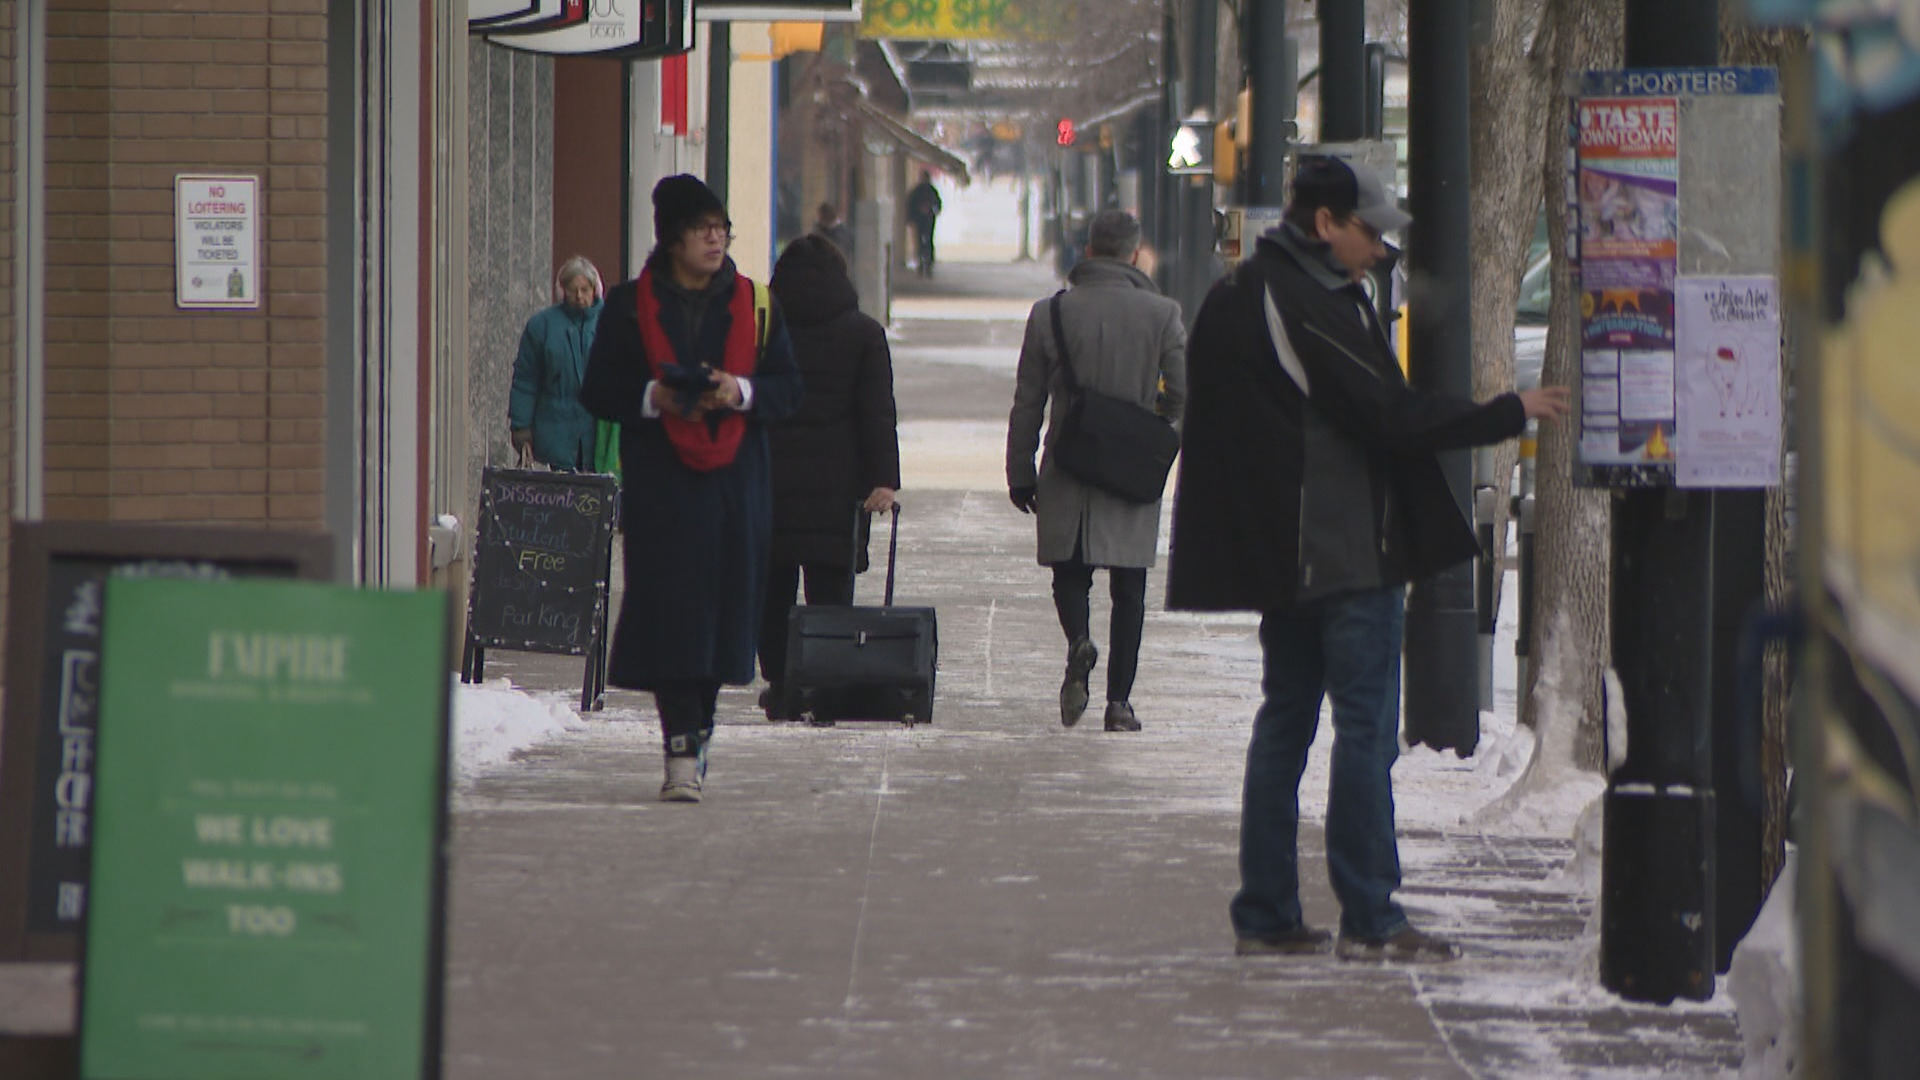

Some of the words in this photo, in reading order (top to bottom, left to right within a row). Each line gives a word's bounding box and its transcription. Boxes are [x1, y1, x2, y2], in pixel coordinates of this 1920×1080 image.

[1596, 105, 1675, 128] TASTE
[208, 186, 225, 198] NO
[188, 201, 247, 215] LOITERING
[193, 221, 243, 232] VIOLATORS
[201, 235, 221, 246] WILL
[222, 235, 235, 246] BE
[197, 249, 239, 261] TICKETED
[498, 522, 569, 549] Student
[519, 551, 565, 571] Free
[195, 814, 244, 844] WE
[251, 816, 333, 849] LOVE
[182, 858, 341, 893] WALK-INS
[225, 904, 296, 936] TOO
